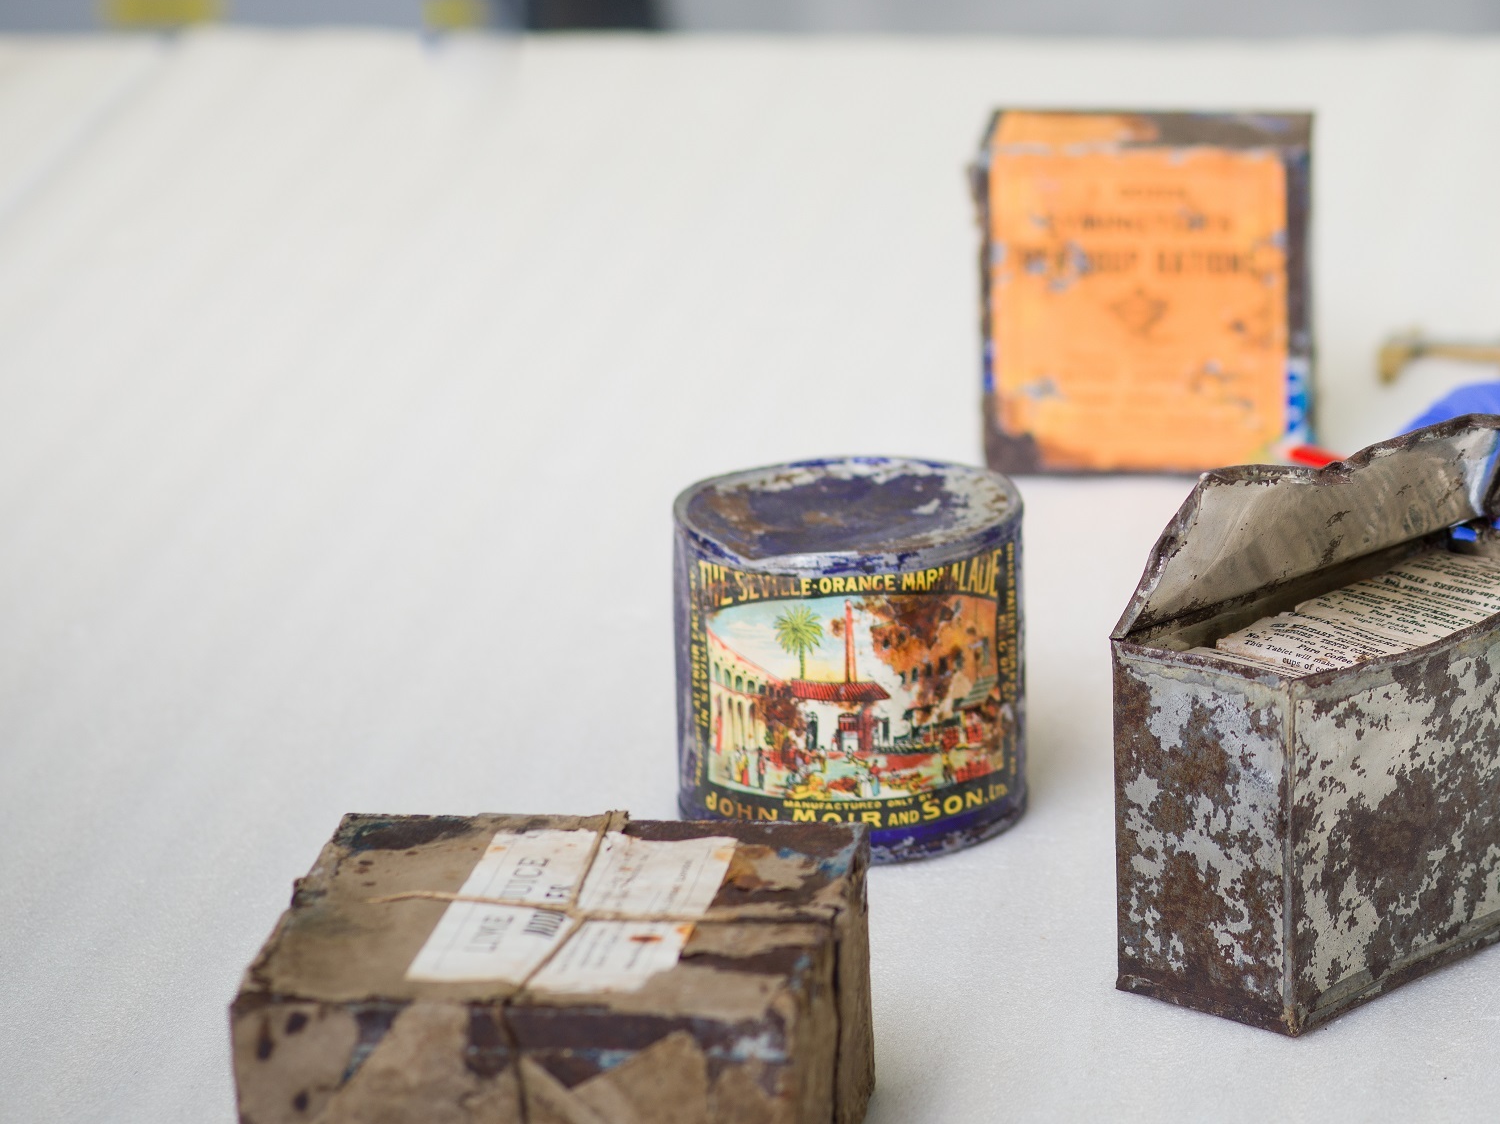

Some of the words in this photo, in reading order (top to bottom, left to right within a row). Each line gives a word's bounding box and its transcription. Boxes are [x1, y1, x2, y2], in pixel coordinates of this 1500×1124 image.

[818, 573, 896, 594] ORANGE
[1369, 609, 1393, 618] Pure
[1396, 616, 1427, 628] Coffee.
[1244, 639, 1262, 648] This
[1266, 644, 1293, 656] Tablet
[1295, 652, 1312, 662] will
[1313, 657, 1336, 667] make
[1296, 643, 1321, 654] Pure
[1324, 652, 1354, 665] Coffee.
[1282, 657, 1301, 670] cups
[1303, 662, 1314, 673] of
[705, 790, 778, 821] JOHN
[792, 808, 882, 827] MOIR
[887, 810, 920, 826] AND
[783, 799, 882, 810] MANUFACTURED
[887, 797, 914, 808] ONLY
[499, 857, 550, 901] UICE
